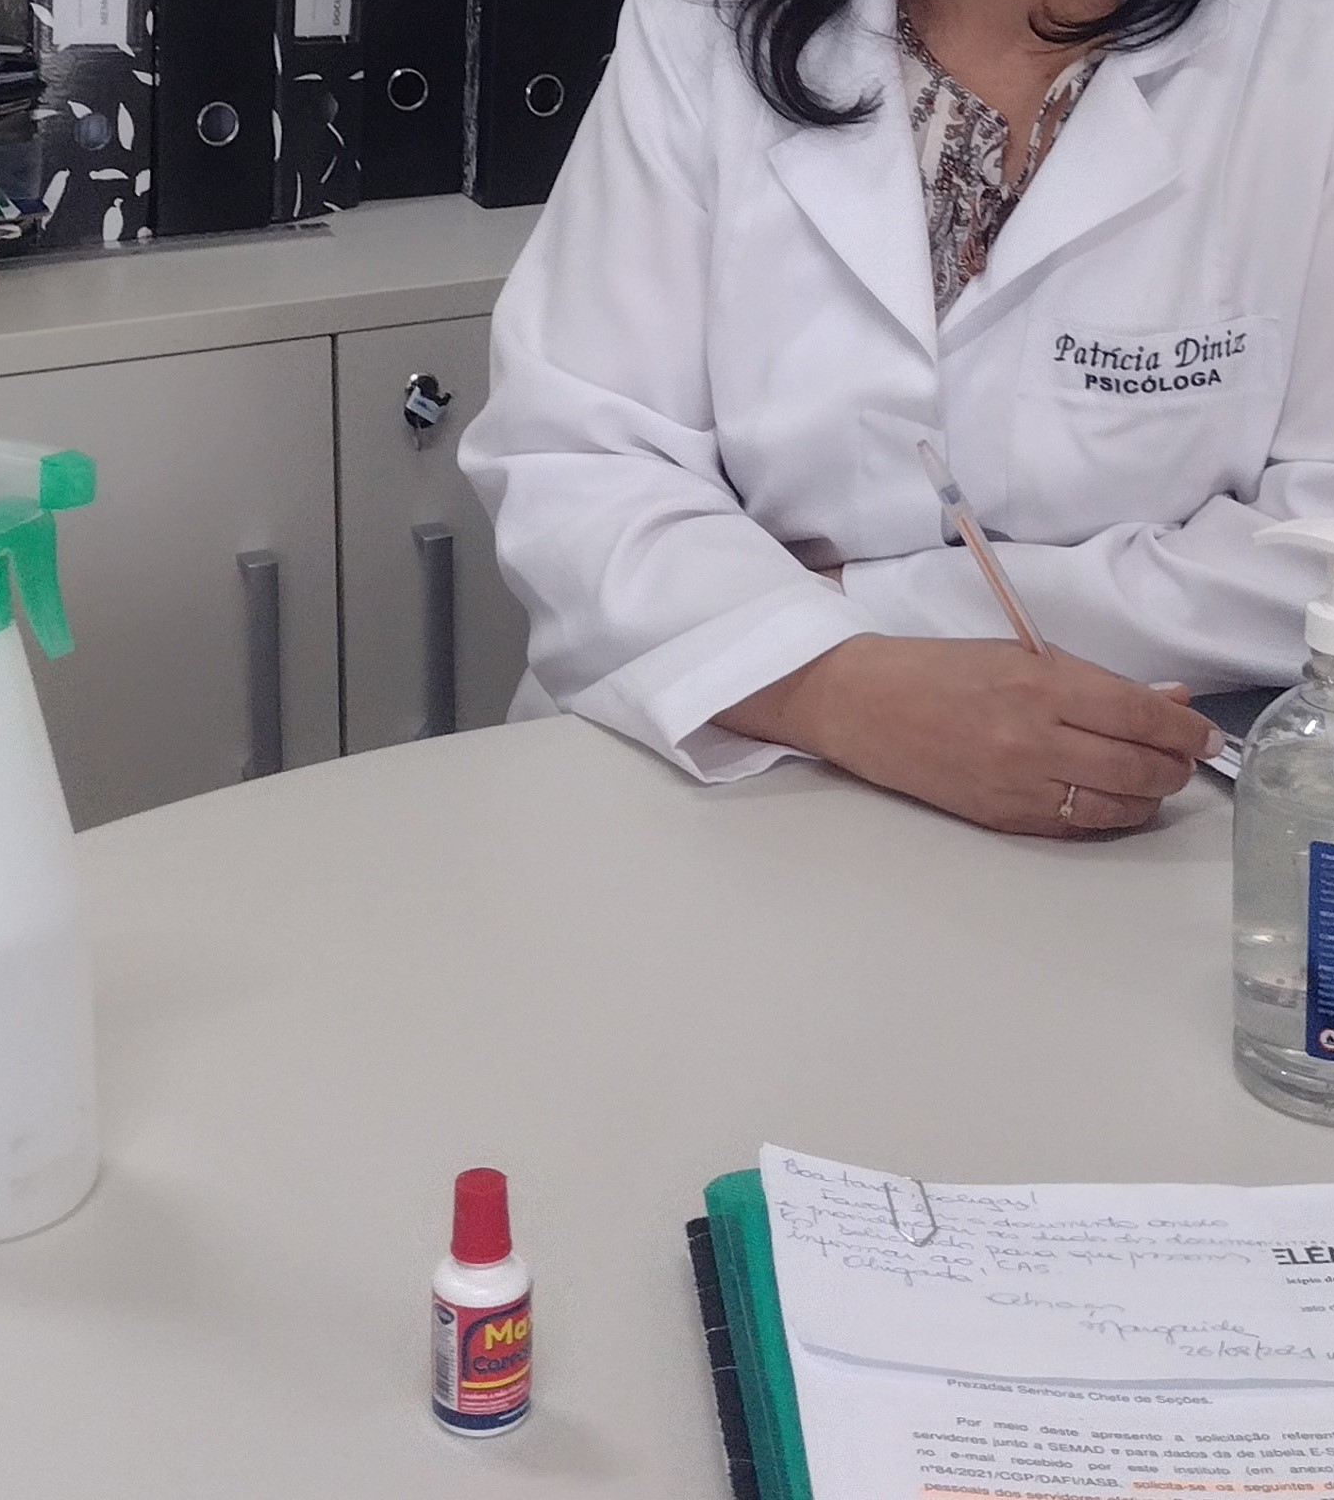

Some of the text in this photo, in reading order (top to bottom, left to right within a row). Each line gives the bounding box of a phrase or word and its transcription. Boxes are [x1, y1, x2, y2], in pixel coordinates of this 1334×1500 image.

[1174, 329, 1248, 369] Diniz
[1084, 368, 1222, 395] PSICÓLOGA
[947, 1378, 1014, 1393] Prezadas
[1017, 1384, 1085, 1400] Senhoras
[912, 1430, 988, 1446] servidores
[992, 1436, 1029, 1450] junto
[1047, 1441, 1105, 1455] SEMAD
[956, 1416, 983, 1428] Por
[993, 1421, 1029, 1432] meio
[1039, 1425, 1080, 1437] deste
[1090, 1430, 1163, 1443] apresento
[1010, 1455, 1074, 1469] recebido
[1087, 1462, 1112, 1472] por
